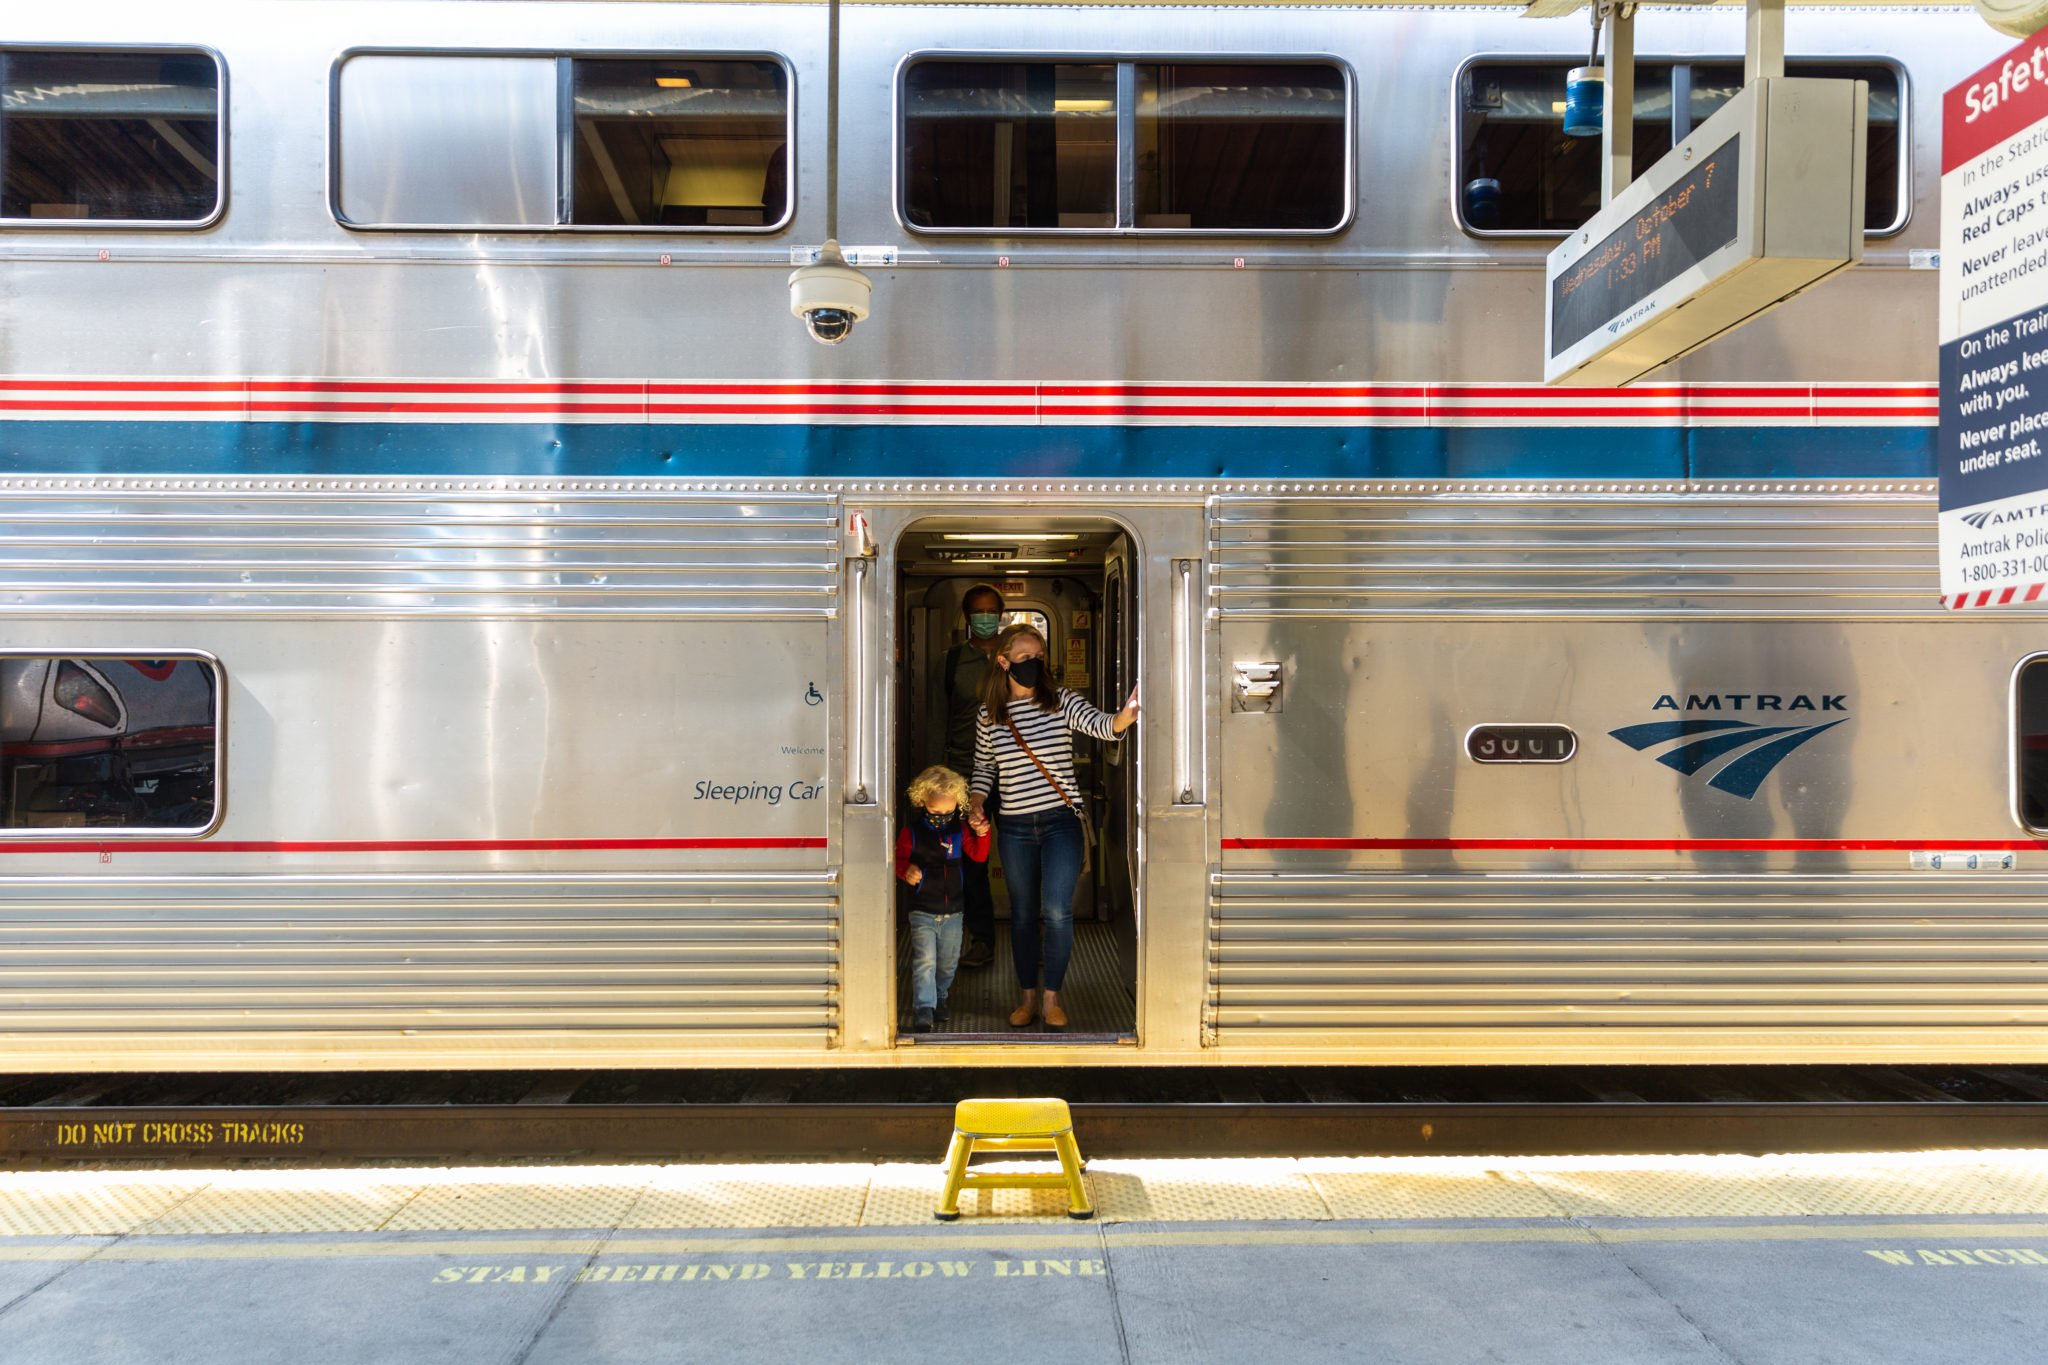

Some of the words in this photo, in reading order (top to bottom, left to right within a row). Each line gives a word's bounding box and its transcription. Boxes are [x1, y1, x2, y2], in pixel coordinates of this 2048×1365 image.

[1963, 170, 1976, 187] In
[1980, 155, 2002, 177] the
[1636, 184, 1696, 240] October
[1705, 162, 1715, 189] 7
[1963, 180, 2020, 220] Always
[1962, 216, 1991, 244] Red
[1996, 198, 2034, 226] Caps
[1608, 252, 1636, 289] 1:33
[1643, 233, 1661, 264] PM
[1962, 245, 2008, 277] Never
[1962, 248, 2047, 301] unattended
[1620, 301, 1656, 328] AMTRAK
[1961, 339, 1981, 358] On
[1984, 328, 2010, 350] the
[1960, 359, 2018, 392] Always
[1960, 390, 1992, 416] with
[1996, 383, 2029, 410] you.
[1960, 423, 2006, 450] Never
[2010, 411, 2048, 440] place
[1960, 450, 2002, 474] under
[2005, 438, 2041, 463] seat.
[1960, 534, 2010, 559] Amtrak
[1002, 582, 1024, 593] EXIT
[1651, 694, 1848, 711] AMTRAK
[781, 746, 824, 755] Welcome
[694, 780, 782, 804] Sleeping
[789, 781, 824, 799] Car
[58, 1124, 86, 1144] DO
[94, 1123, 136, 1144] NOT
[143, 1123, 213, 1144] CROSS
[221, 1123, 304, 1144] TRACKS
[431, 1266, 566, 1283] STAY
[572, 1263, 772, 1283] BEHIND
[787, 1260, 977, 1279] YELLOW
[992, 1259, 1107, 1277] LINE
[1862, 1249, 2048, 1266] WATCH
